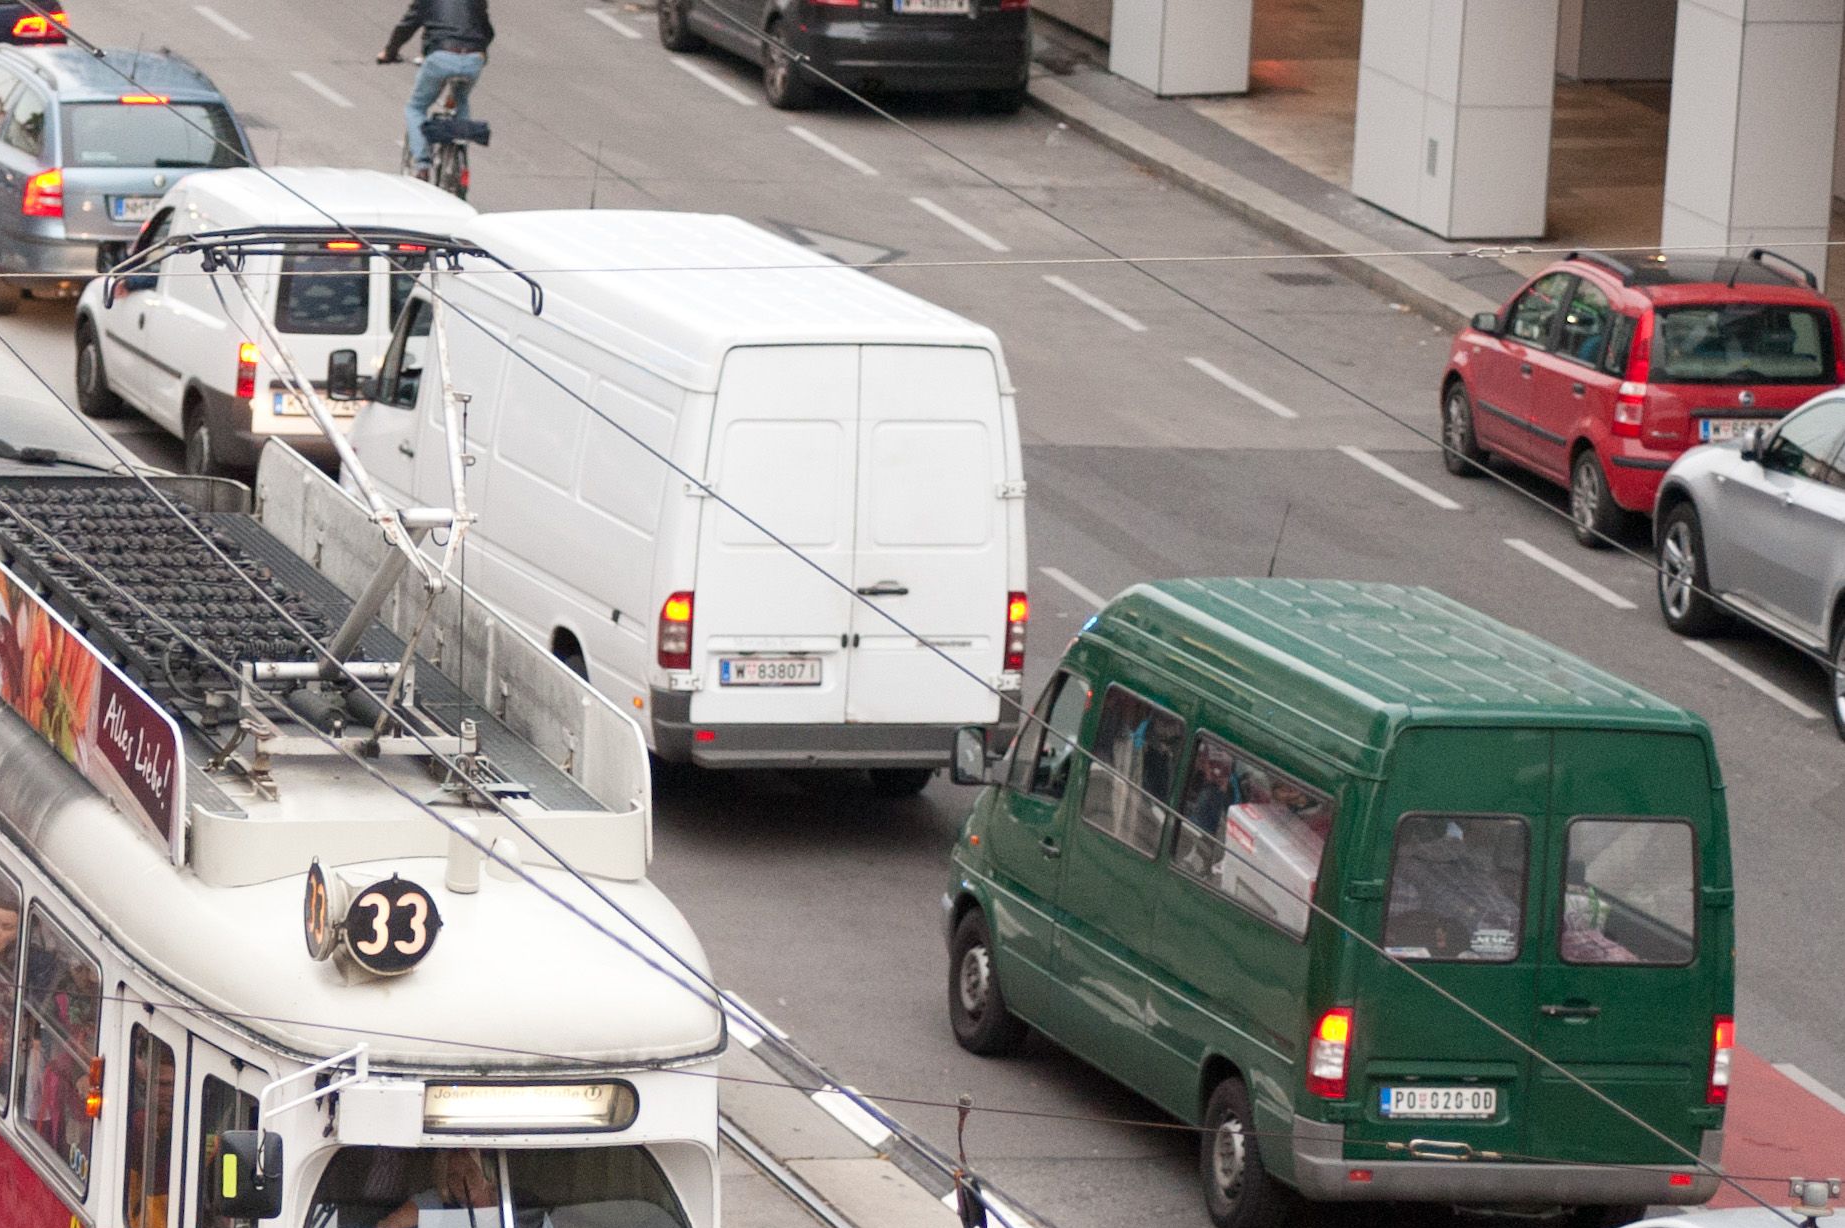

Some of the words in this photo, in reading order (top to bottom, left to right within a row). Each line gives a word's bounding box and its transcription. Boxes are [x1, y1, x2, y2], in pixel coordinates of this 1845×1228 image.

[103, 692, 134, 762] Alles
[134, 727, 171, 810] Liebe!
[357, 892, 428, 956] 33
[1395, 1091, 1416, 1109] PO
